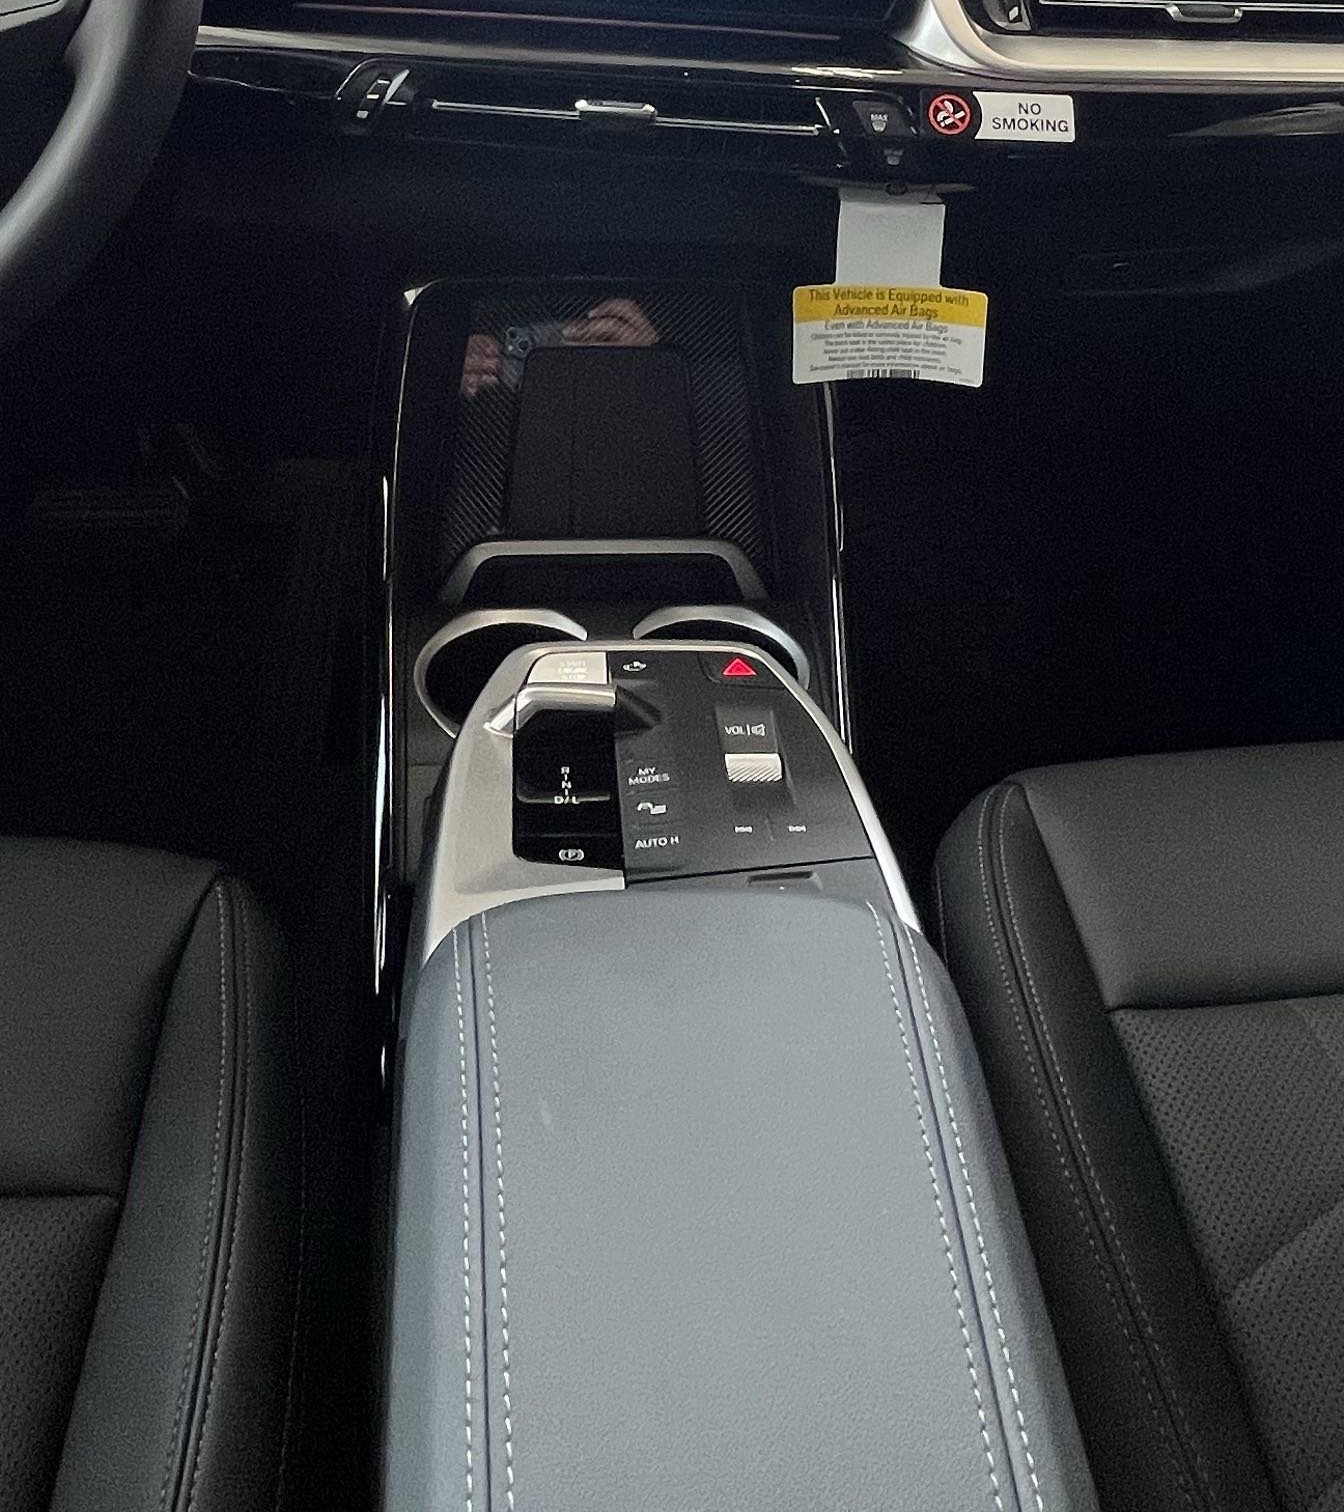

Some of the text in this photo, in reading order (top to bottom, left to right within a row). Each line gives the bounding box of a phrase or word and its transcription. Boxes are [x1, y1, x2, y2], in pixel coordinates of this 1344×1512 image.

[1018, 103, 1041, 115] NO
[991, 117, 1069, 133] SMOKING
[810, 288, 969, 307] This Vehicle is Equipped with
[834, 304, 939, 320] Advanced Air Bags
[824, 321, 845, 331] Even
[866, 319, 909, 330] Advanced
[911, 320, 924, 330] Air
[927, 321, 949, 334] Bags
[724, 725, 745, 735] VOL
[638, 767, 656, 775] MY
[628, 773, 670, 785] MODES
[635, 836, 679, 849] AUTO H
